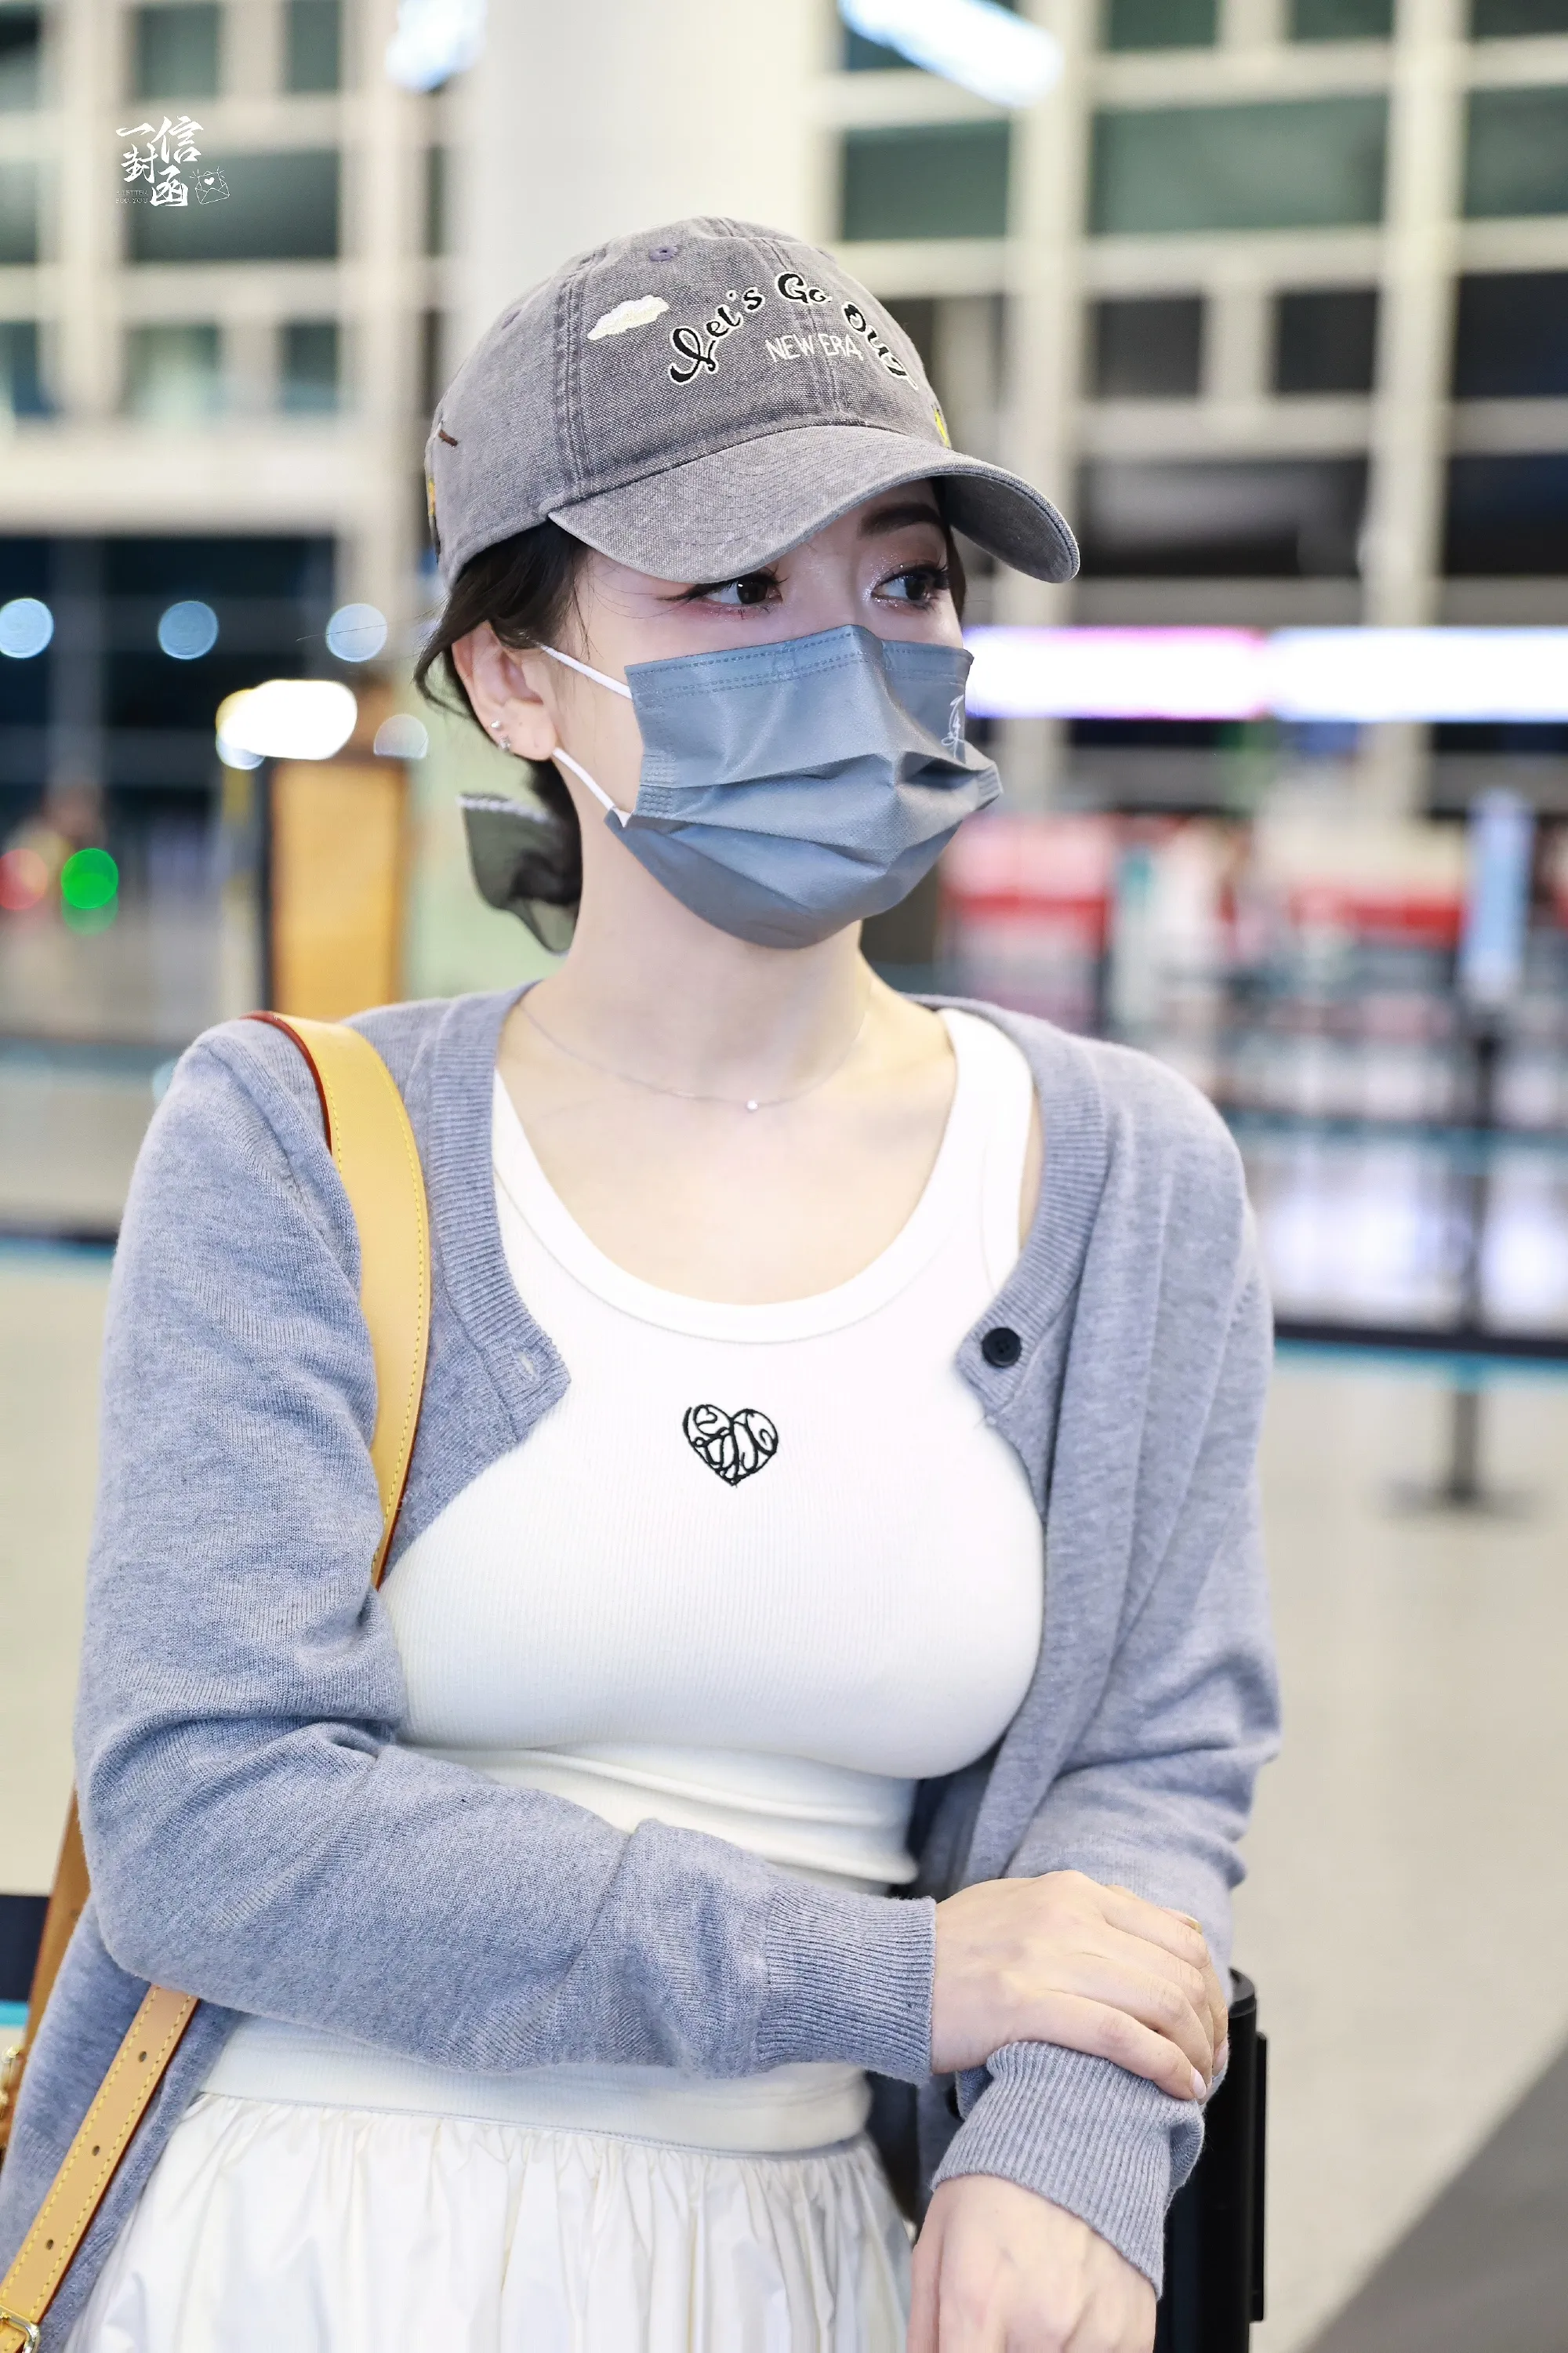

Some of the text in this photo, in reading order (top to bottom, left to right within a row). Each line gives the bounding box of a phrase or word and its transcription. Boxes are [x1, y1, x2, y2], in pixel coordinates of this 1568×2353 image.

[668, 287, 765, 385] Let's
[775, 271, 833, 305] Go
[765, 333, 864, 363] NEW ERA
